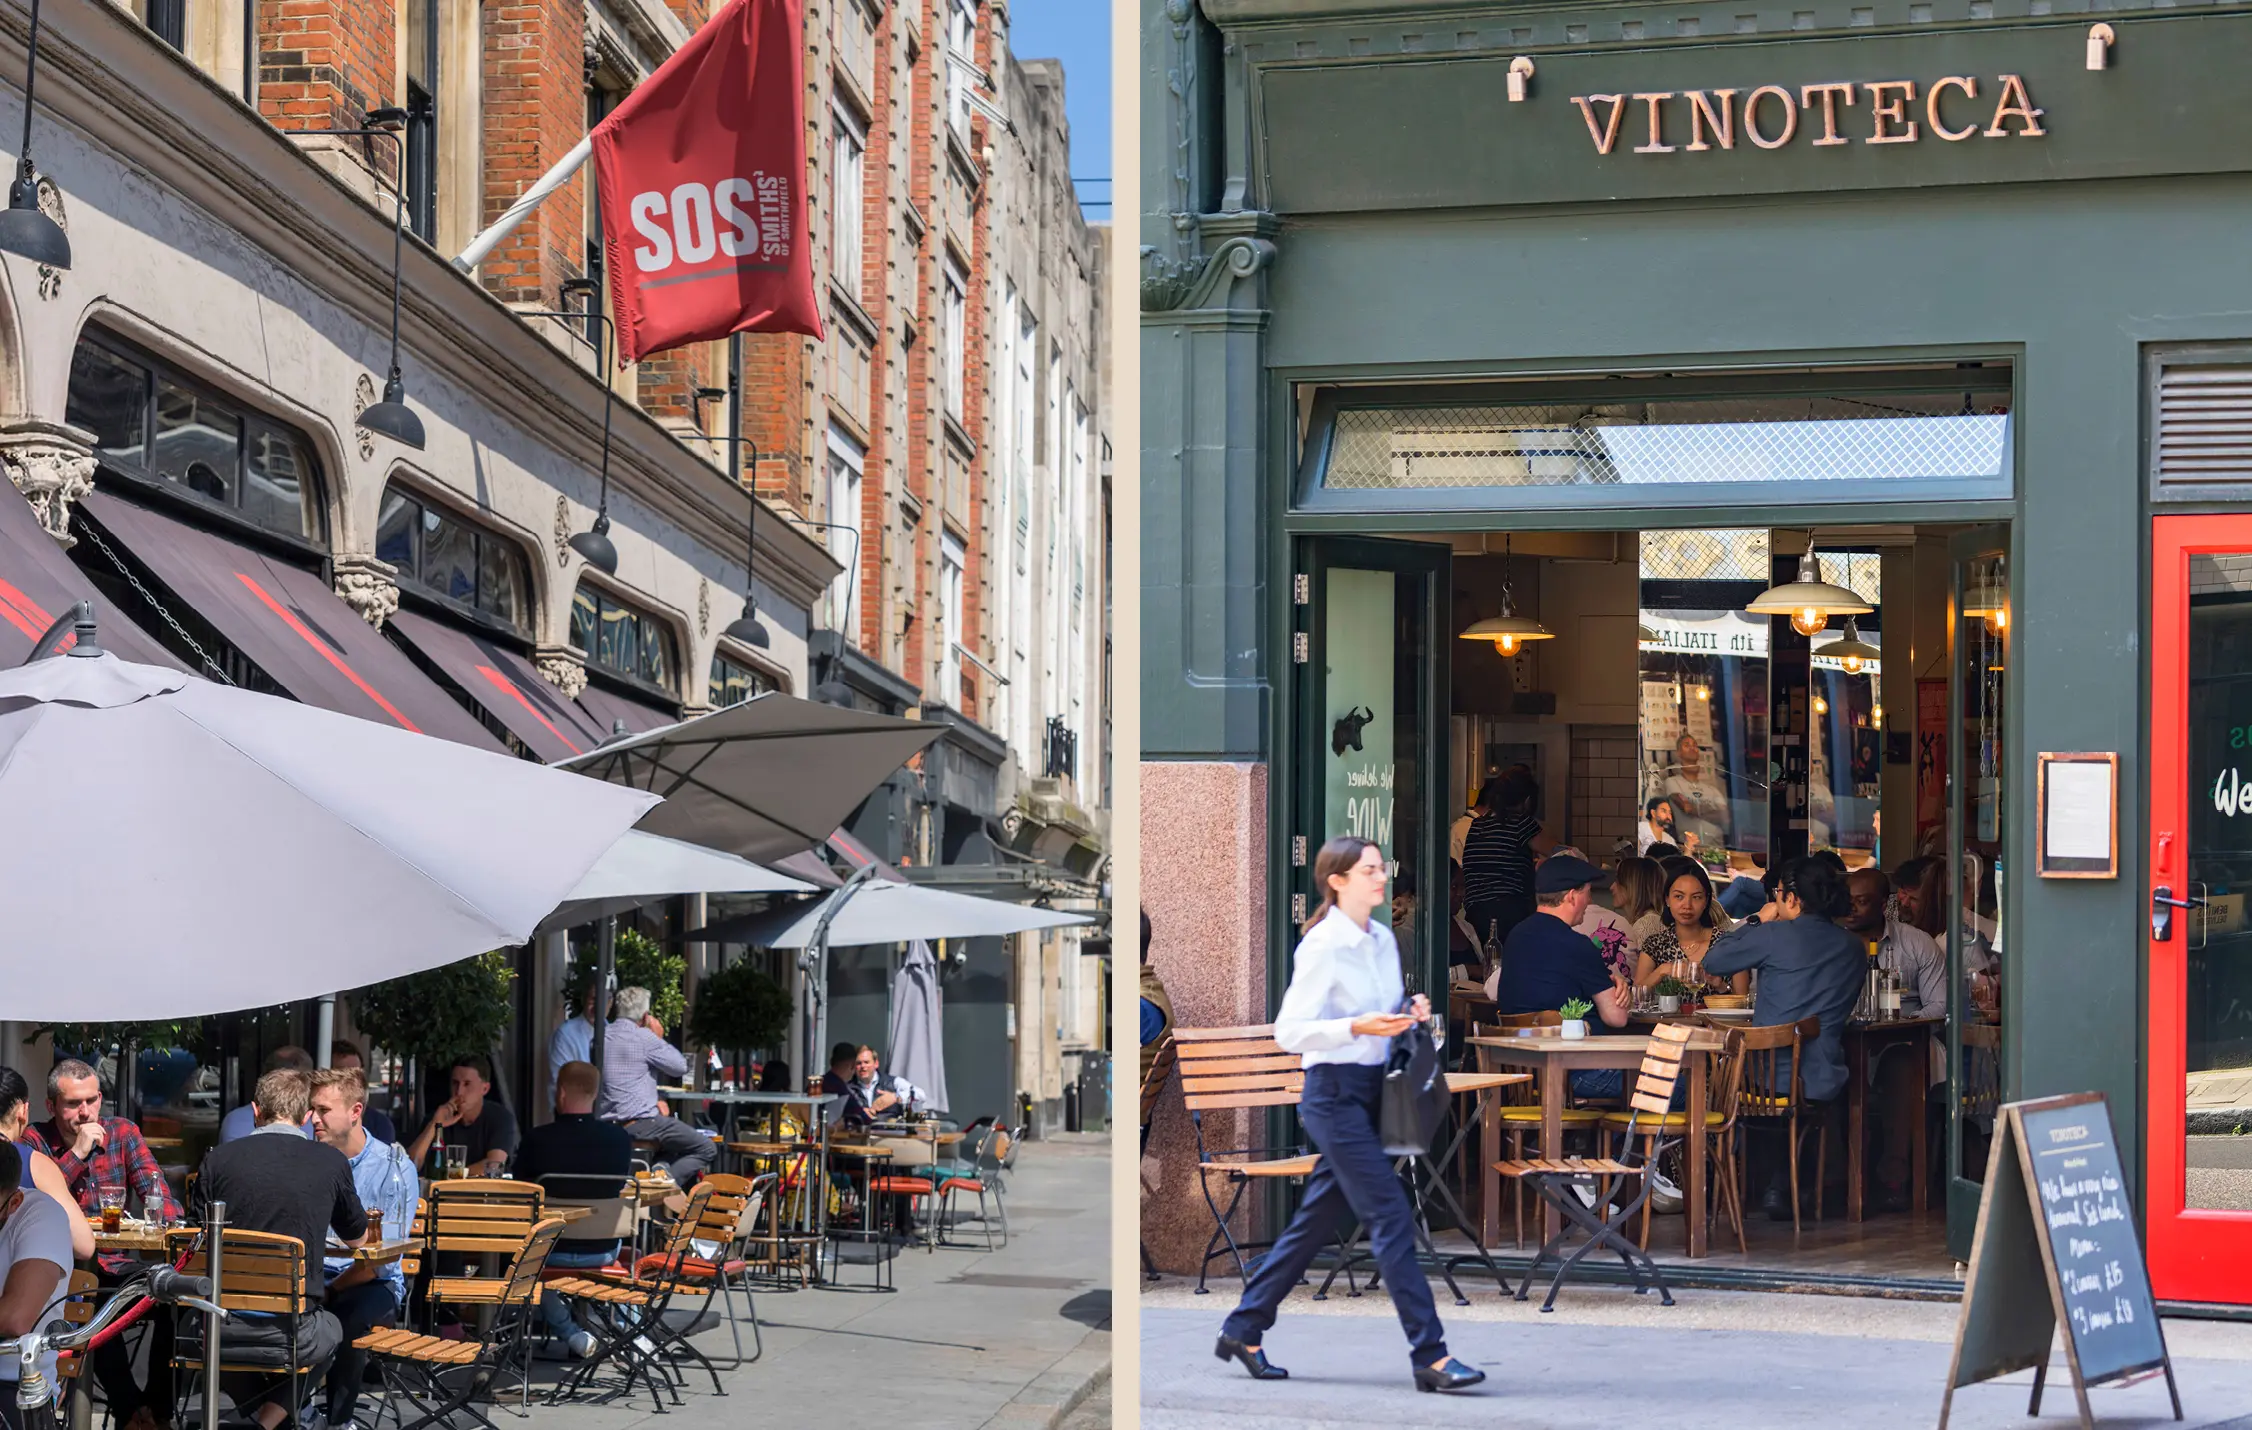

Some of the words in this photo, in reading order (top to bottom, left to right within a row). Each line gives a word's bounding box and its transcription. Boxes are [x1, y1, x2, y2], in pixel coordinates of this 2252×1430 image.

[1570, 74, 2047, 155] VINOTECA
[630, 177, 759, 272] SOS
[778, 177, 790, 240] SMITHFIELD
[780, 243, 790, 257] OF
